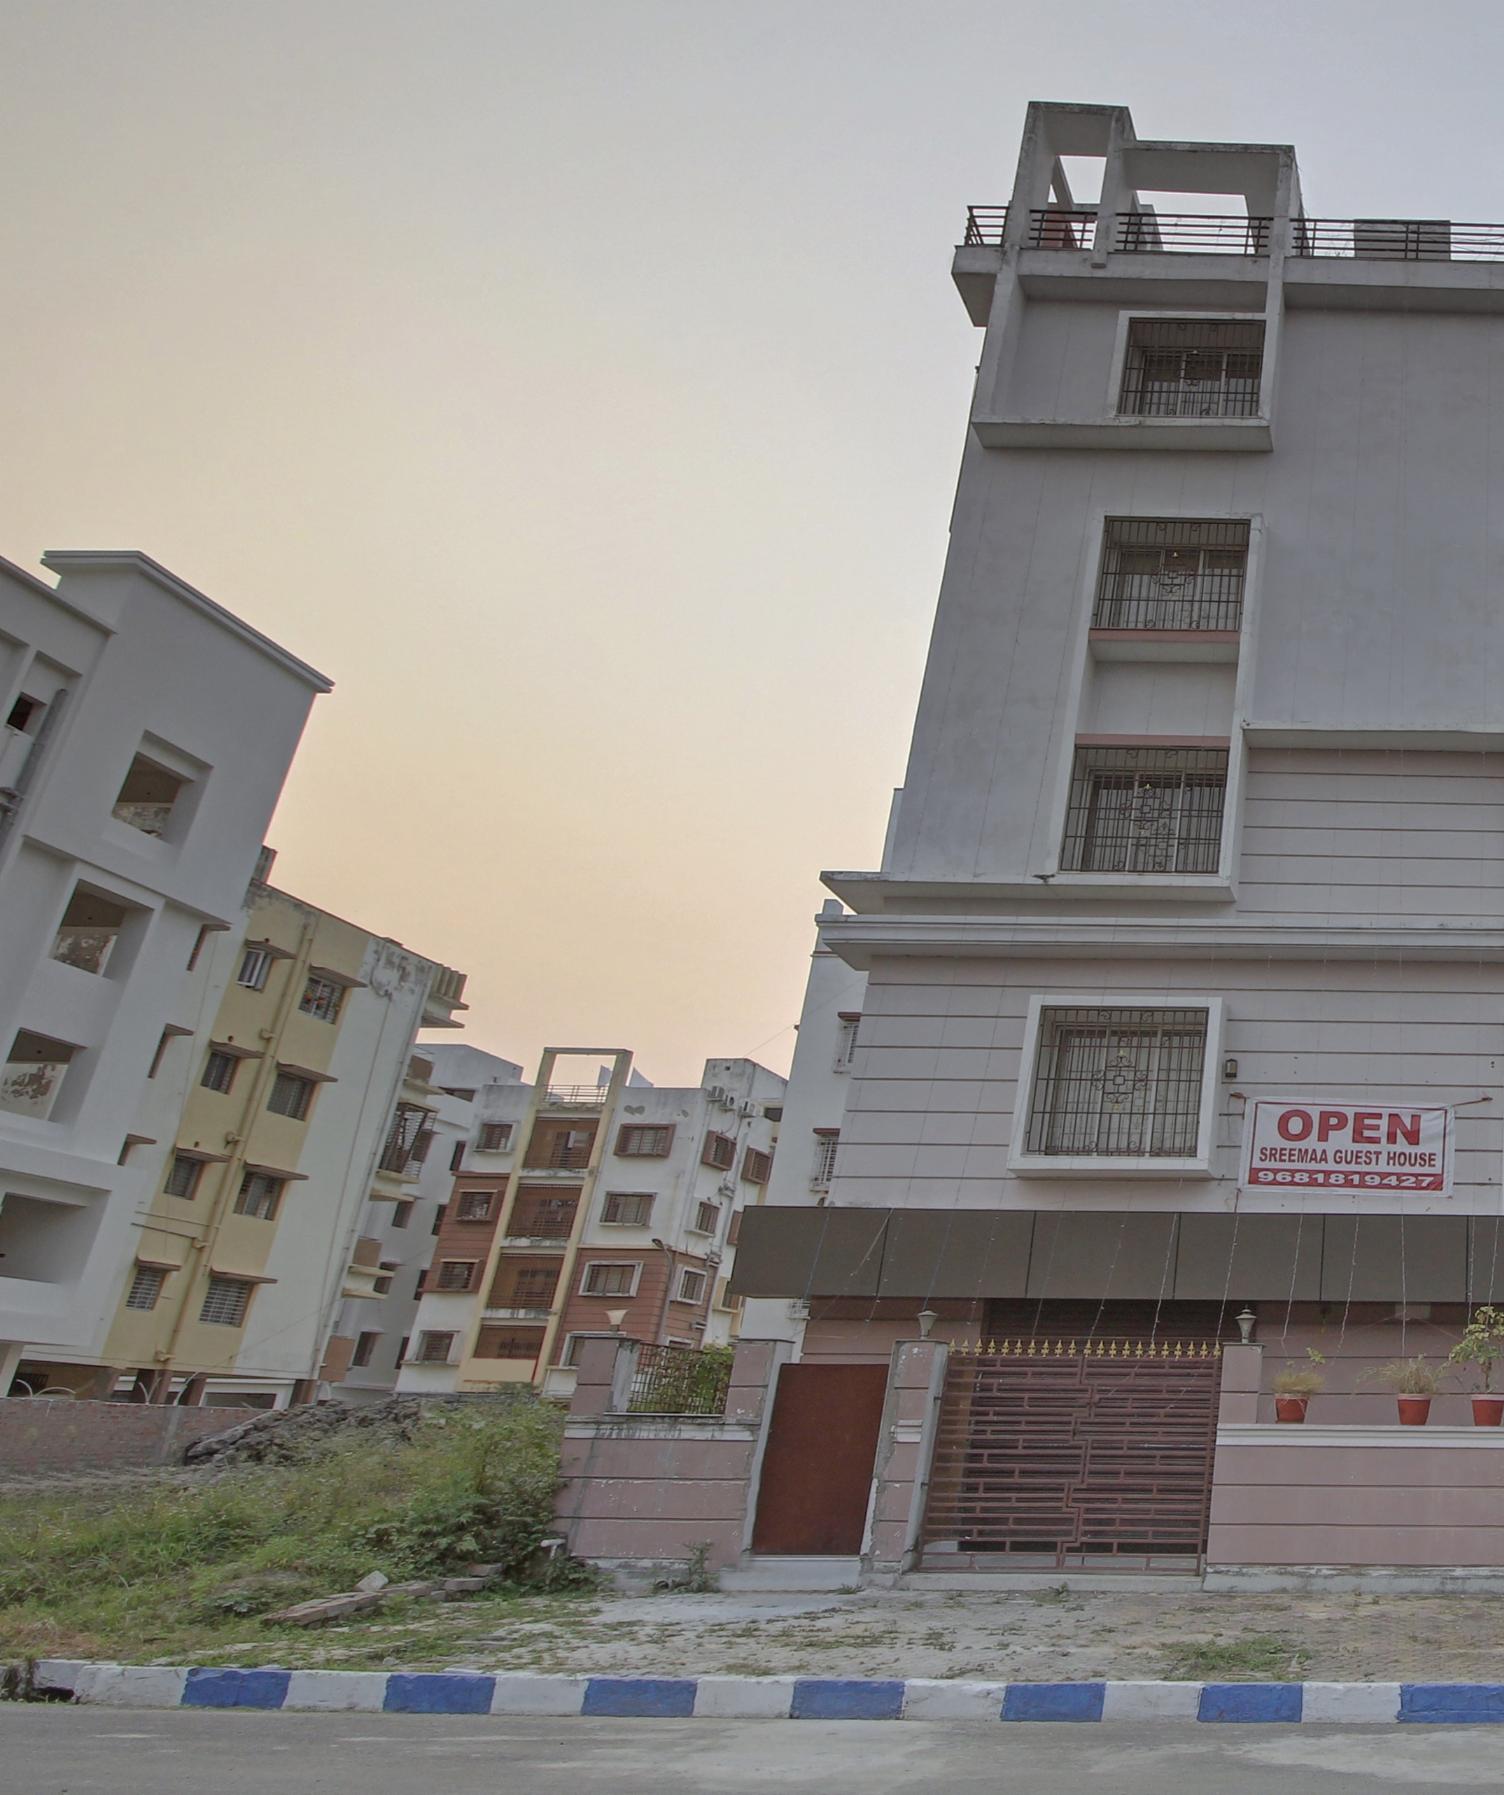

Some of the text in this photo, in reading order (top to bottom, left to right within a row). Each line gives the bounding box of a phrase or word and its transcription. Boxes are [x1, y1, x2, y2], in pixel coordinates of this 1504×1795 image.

[1277, 1109, 1421, 1146] OPEN
[1259, 1147, 1437, 1168] SREEMAA GUEST HOUSE
[1257, 1171, 1435, 1187] 9681819427
